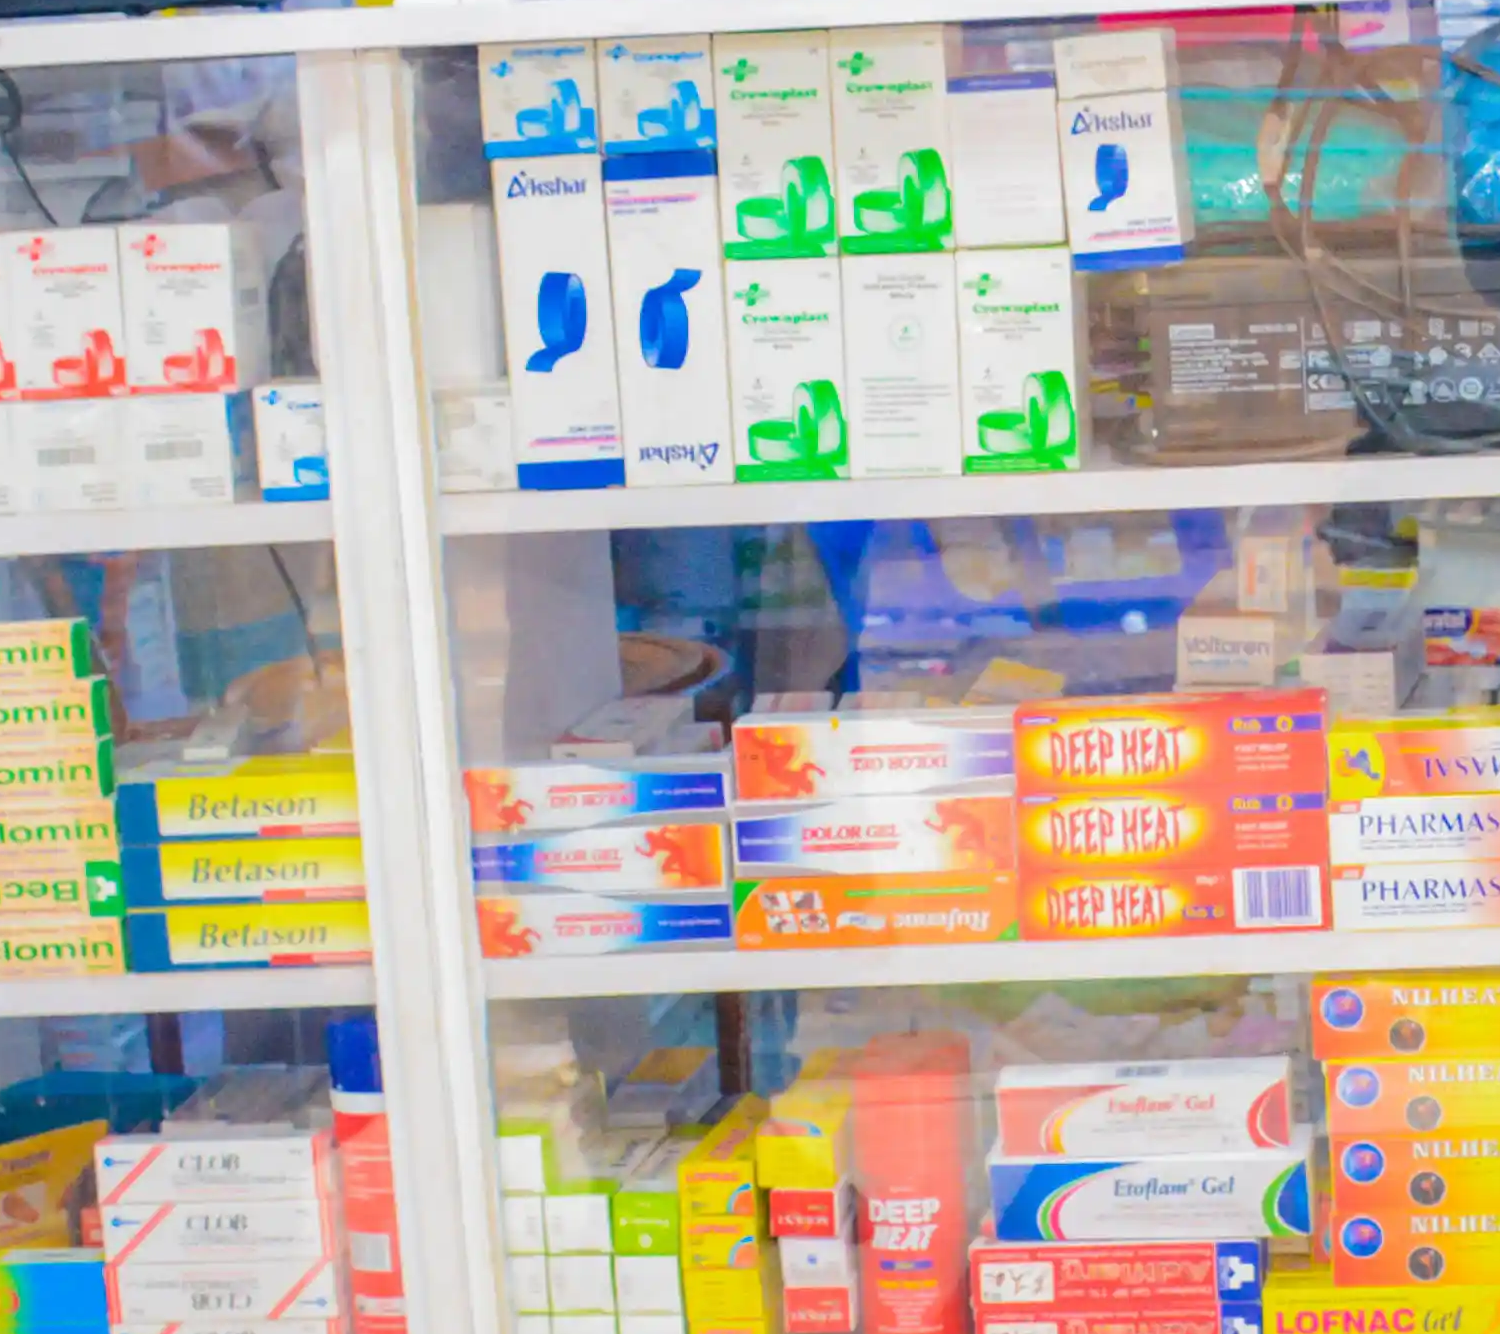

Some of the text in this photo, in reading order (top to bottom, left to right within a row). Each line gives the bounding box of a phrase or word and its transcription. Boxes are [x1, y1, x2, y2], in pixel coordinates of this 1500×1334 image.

[1049, 724, 1186, 777] DEEP HEAT
[186, 791, 319, 821] Betason
[801, 822, 903, 843] DOLOR GEL
[1049, 803, 1186, 855] DEEP HEAT
[592, 847, 624, 864] GEL
[190, 856, 321, 886] Betason
[1045, 882, 1171, 929] DEEP HEAT
[198, 920, 328, 952] Betason
[1185, 1094, 1216, 1111] Gel
[1201, 1175, 1236, 1195] Gel
[868, 1197, 941, 1224] DEEP
[871, 1224, 938, 1251] HEAT
[1421, 1304, 1464, 1334] Gel
